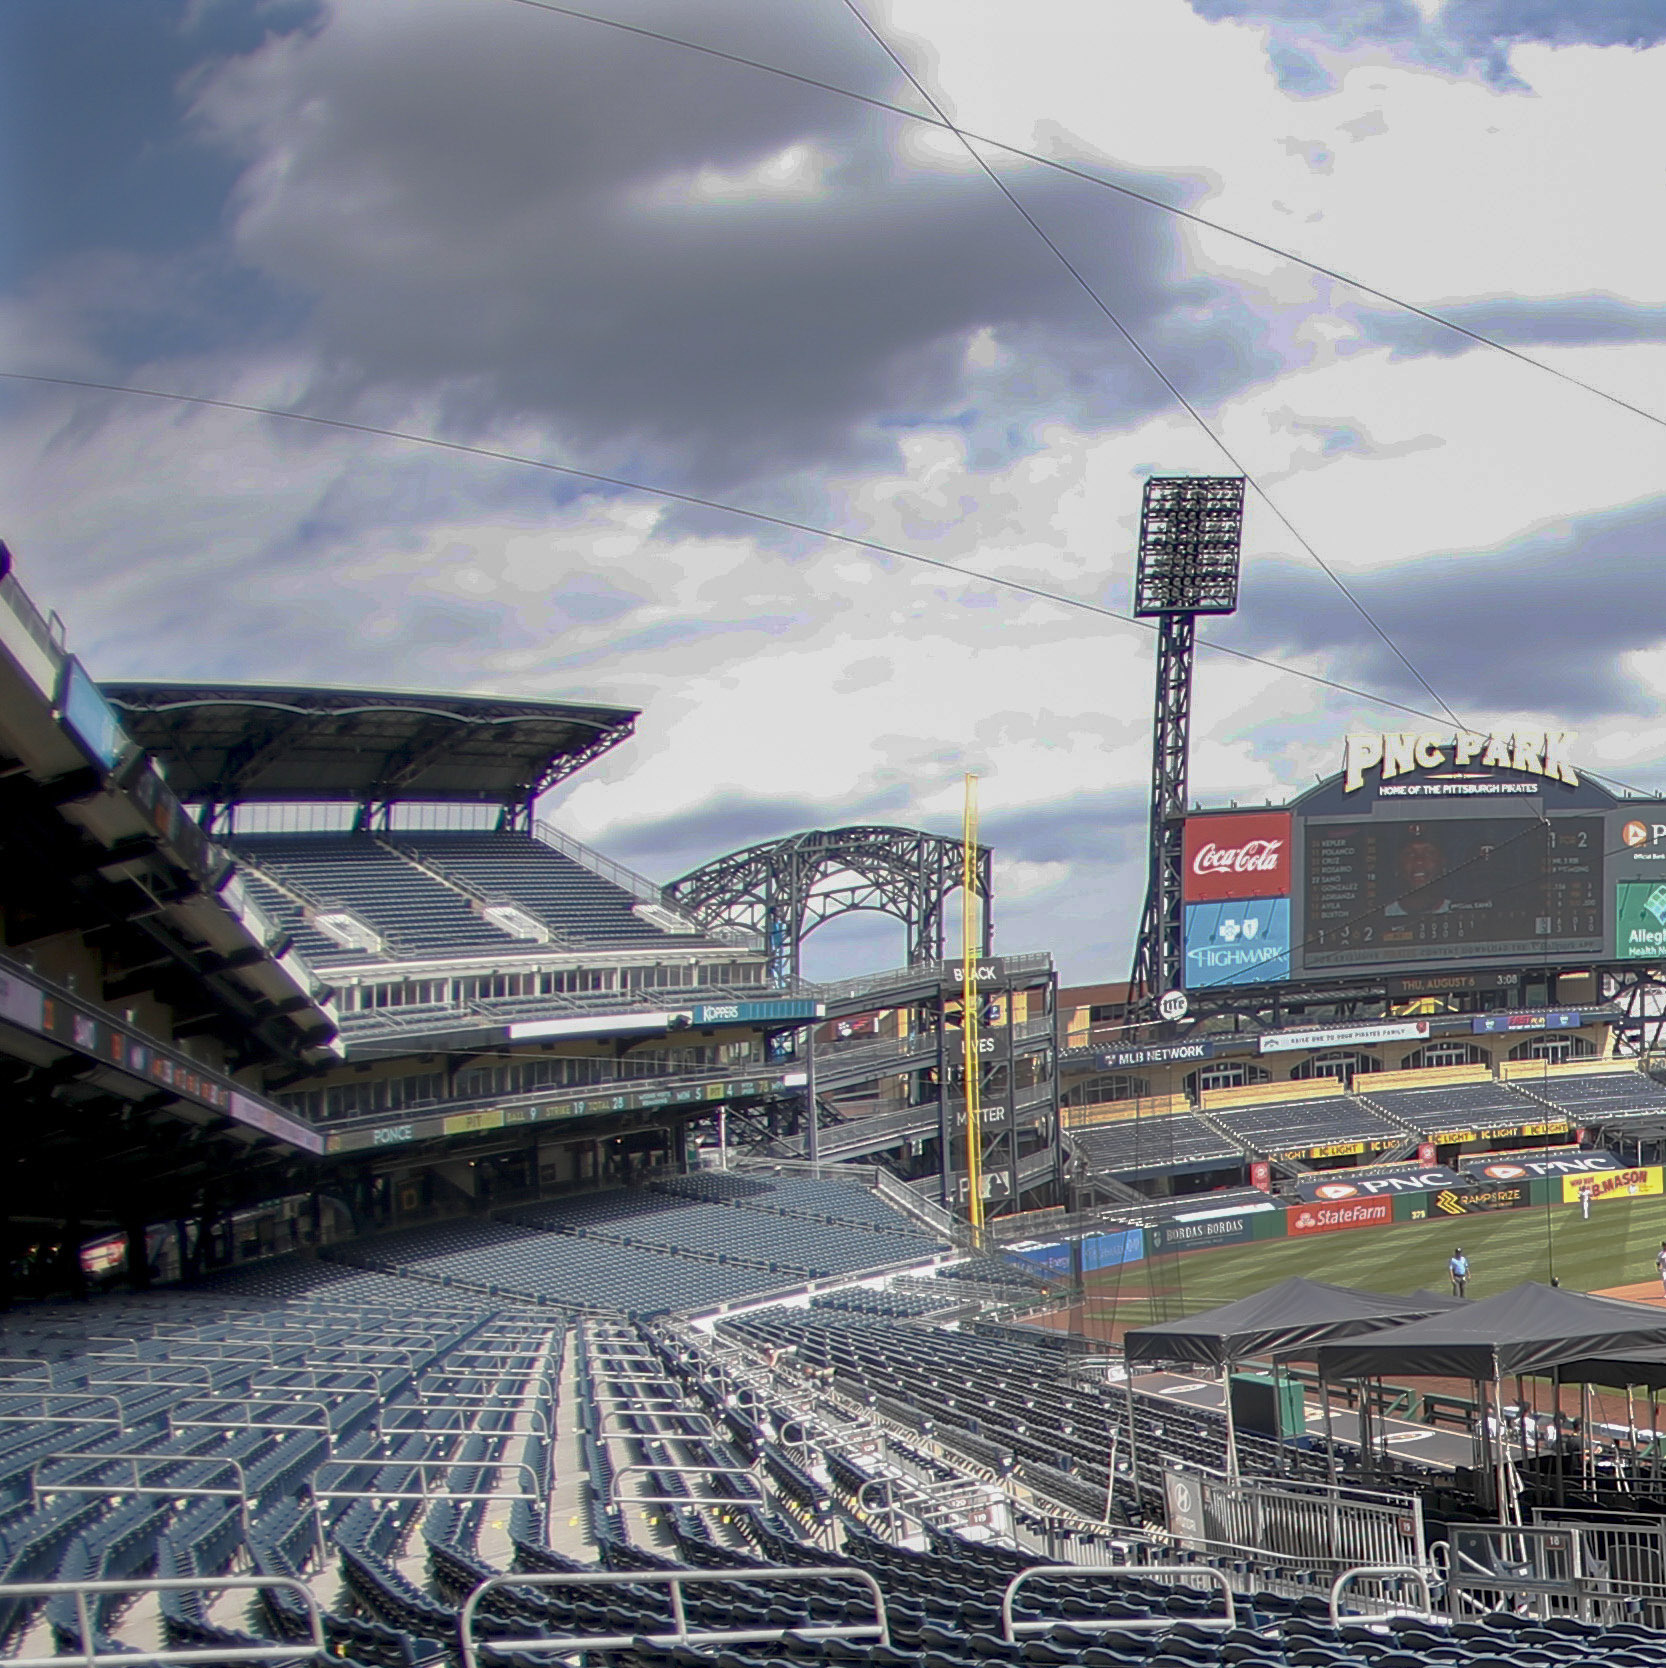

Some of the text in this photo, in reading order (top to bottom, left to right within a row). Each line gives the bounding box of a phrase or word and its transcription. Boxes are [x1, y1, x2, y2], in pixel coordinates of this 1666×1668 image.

[1345, 732, 1580, 793] PNC PARK
[1379, 783, 1539, 796] HOME OF THE PITTSBURGH PIRATES
[1198, 945, 1284, 970] HIGHMARK
[1629, 946, 1657, 956] Health
[1403, 981, 1424, 990] THU,
[1427, 978, 1466, 989] AUGUST
[1496, 975, 1518, 985] 3:08
[1119, 1045, 1204, 1065] MLB NETWORK
[373, 1125, 413, 1145] PONCE
[530, 1107, 538, 1121] 9
[545, 1103, 571, 1117] STRIKE
[574, 1101, 585, 1115] 19
[588, 1099, 611, 1112] TOTAL
[1492, 1128, 1518, 1138] LIGHT
[1319, 1143, 1357, 1156] IC LIGHT
[1524, 1158, 1617, 1176] PNC
[1358, 1174, 1453, 1194] PNC
[1166, 1219, 1243, 1242] BORDAS BORDAS
